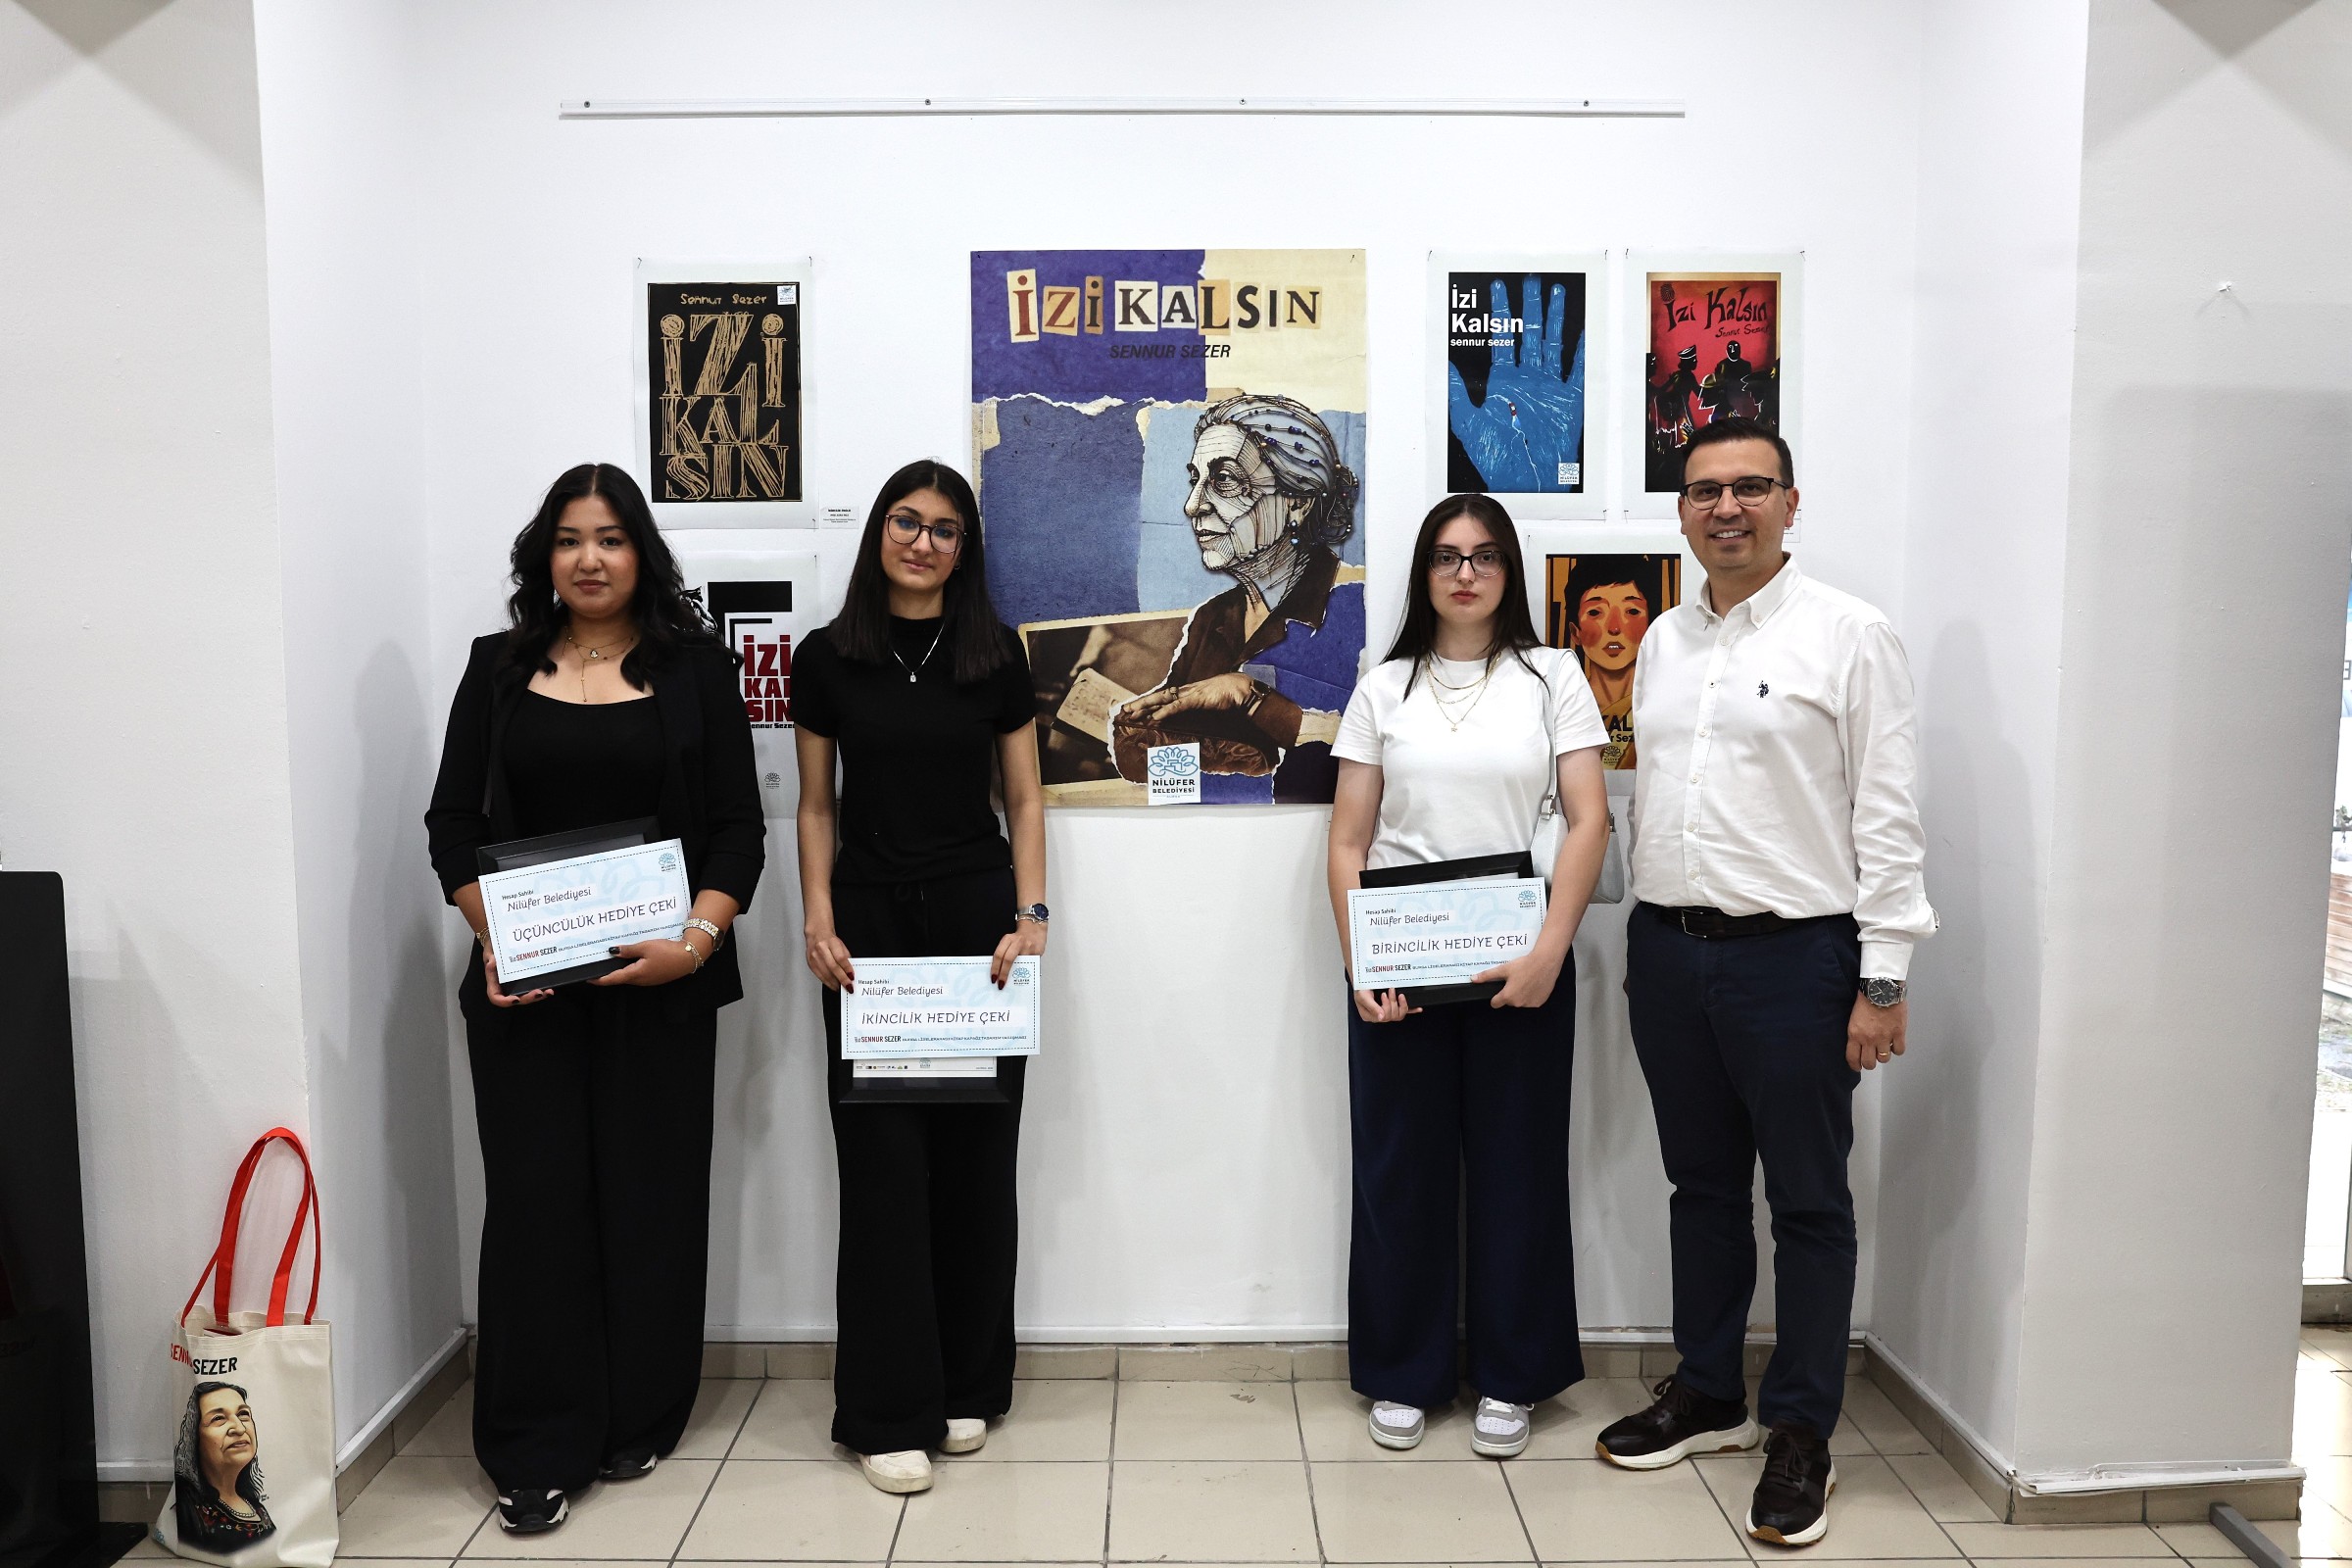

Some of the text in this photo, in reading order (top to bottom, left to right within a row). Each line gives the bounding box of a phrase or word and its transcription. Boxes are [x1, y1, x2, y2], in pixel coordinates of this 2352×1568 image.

[681, 293, 722, 305] Sennur
[732, 293, 767, 305] Sezer
[1013, 275, 1319, 336] İZİ KALSIN
[1452, 284, 1477, 309] İzi
[1451, 313, 1524, 333] Kalsın
[1110, 344, 1231, 359] SENNUR SEZER
[1450, 338, 1515, 347] sennur sezer
[665, 444, 789, 501] SIN
[745, 699, 795, 722] SIN
[1152, 778, 1196, 787] NİLÜFER
[508, 887, 591, 911] Nilüfer Belediyesi
[513, 896, 676, 942] ÜÇÜNCÜLÜK HEDİYE ÇEKİ
[1370, 912, 1449, 927] Nilüfer Belediyesi
[515, 951, 540, 961] SENNUR
[539, 946, 558, 956] SEZER
[1372, 934, 1527, 955] BİRİNCİLİK HEDİYE ÇEKİ
[861, 986, 943, 998] Nilüfer Belediyesi
[862, 1010, 1010, 1025] İKİNCİLİK HEDİYE ÇEKİ
[193, 1357, 238, 1375] SEZER
